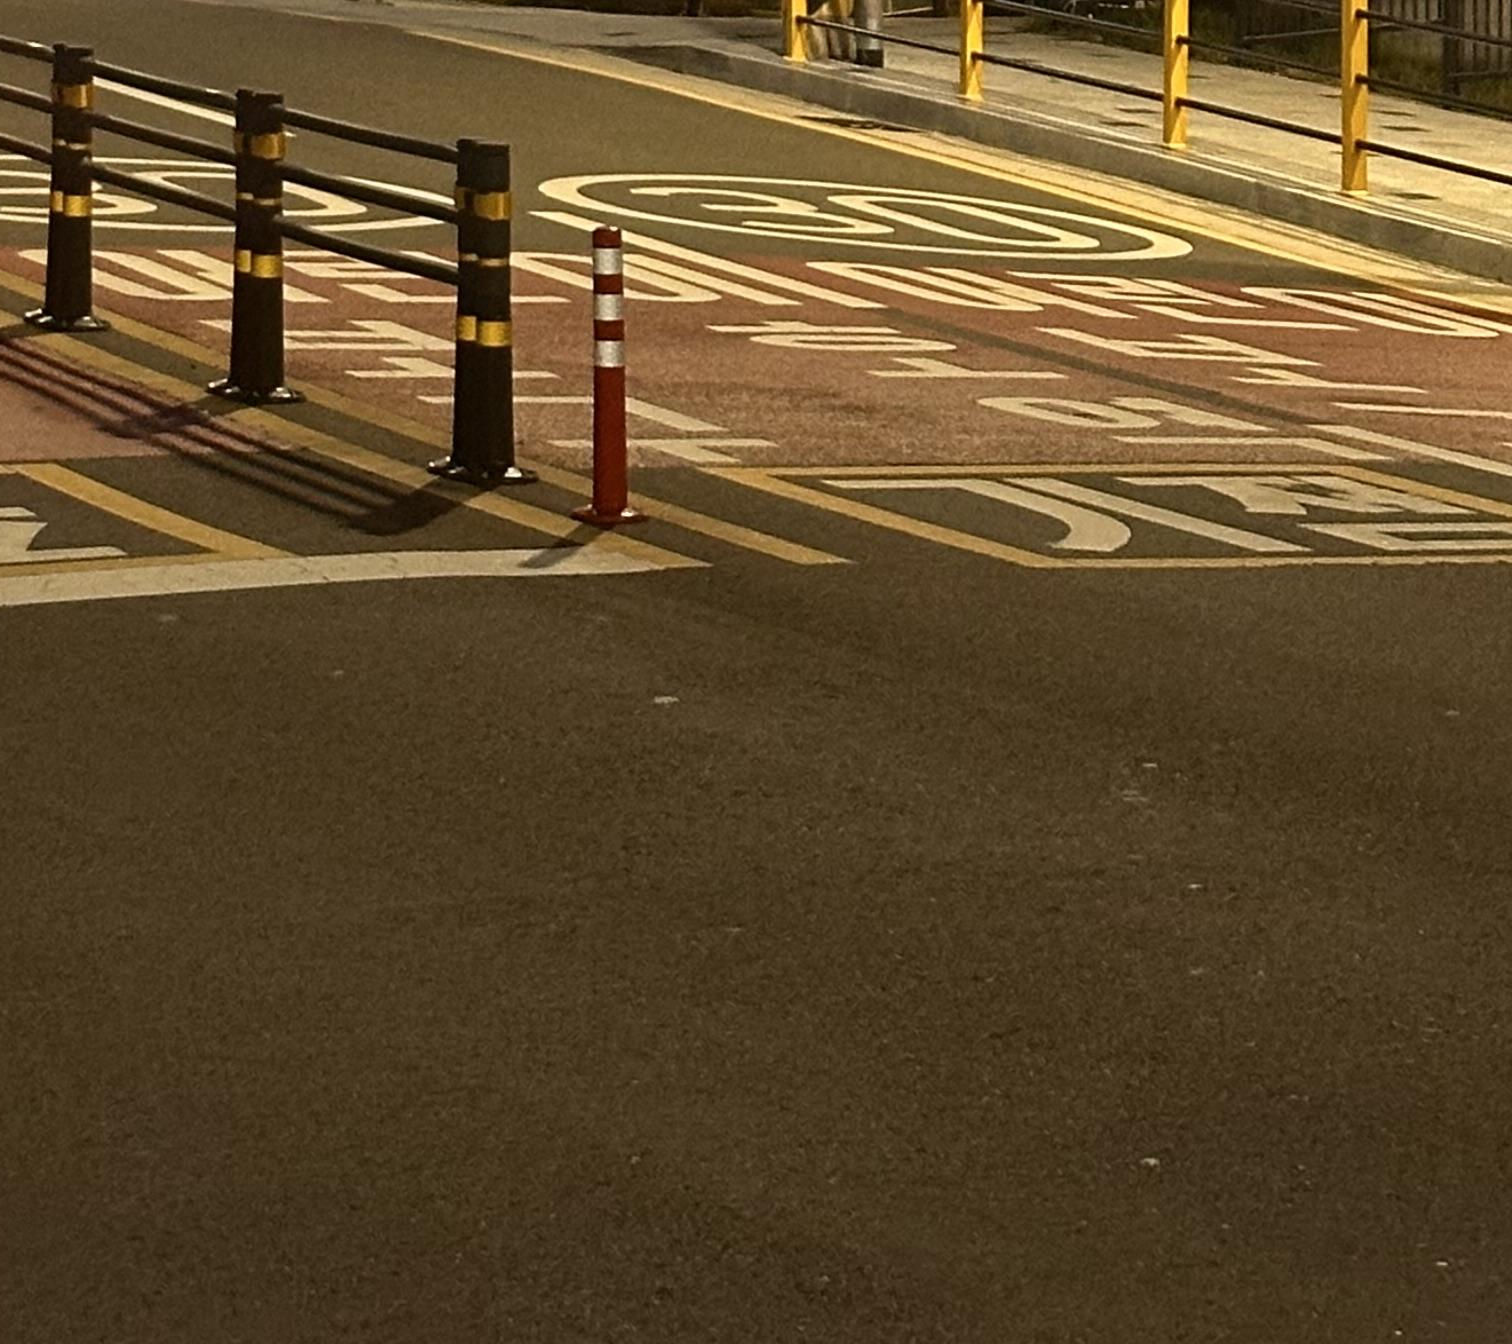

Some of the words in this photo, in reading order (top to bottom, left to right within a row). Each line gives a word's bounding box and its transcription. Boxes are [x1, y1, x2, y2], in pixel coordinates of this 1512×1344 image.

[629, 186, 1101, 249] 30
[805, 260, 1512, 338] 어린이
[821, 475, 1512, 553] 기점
